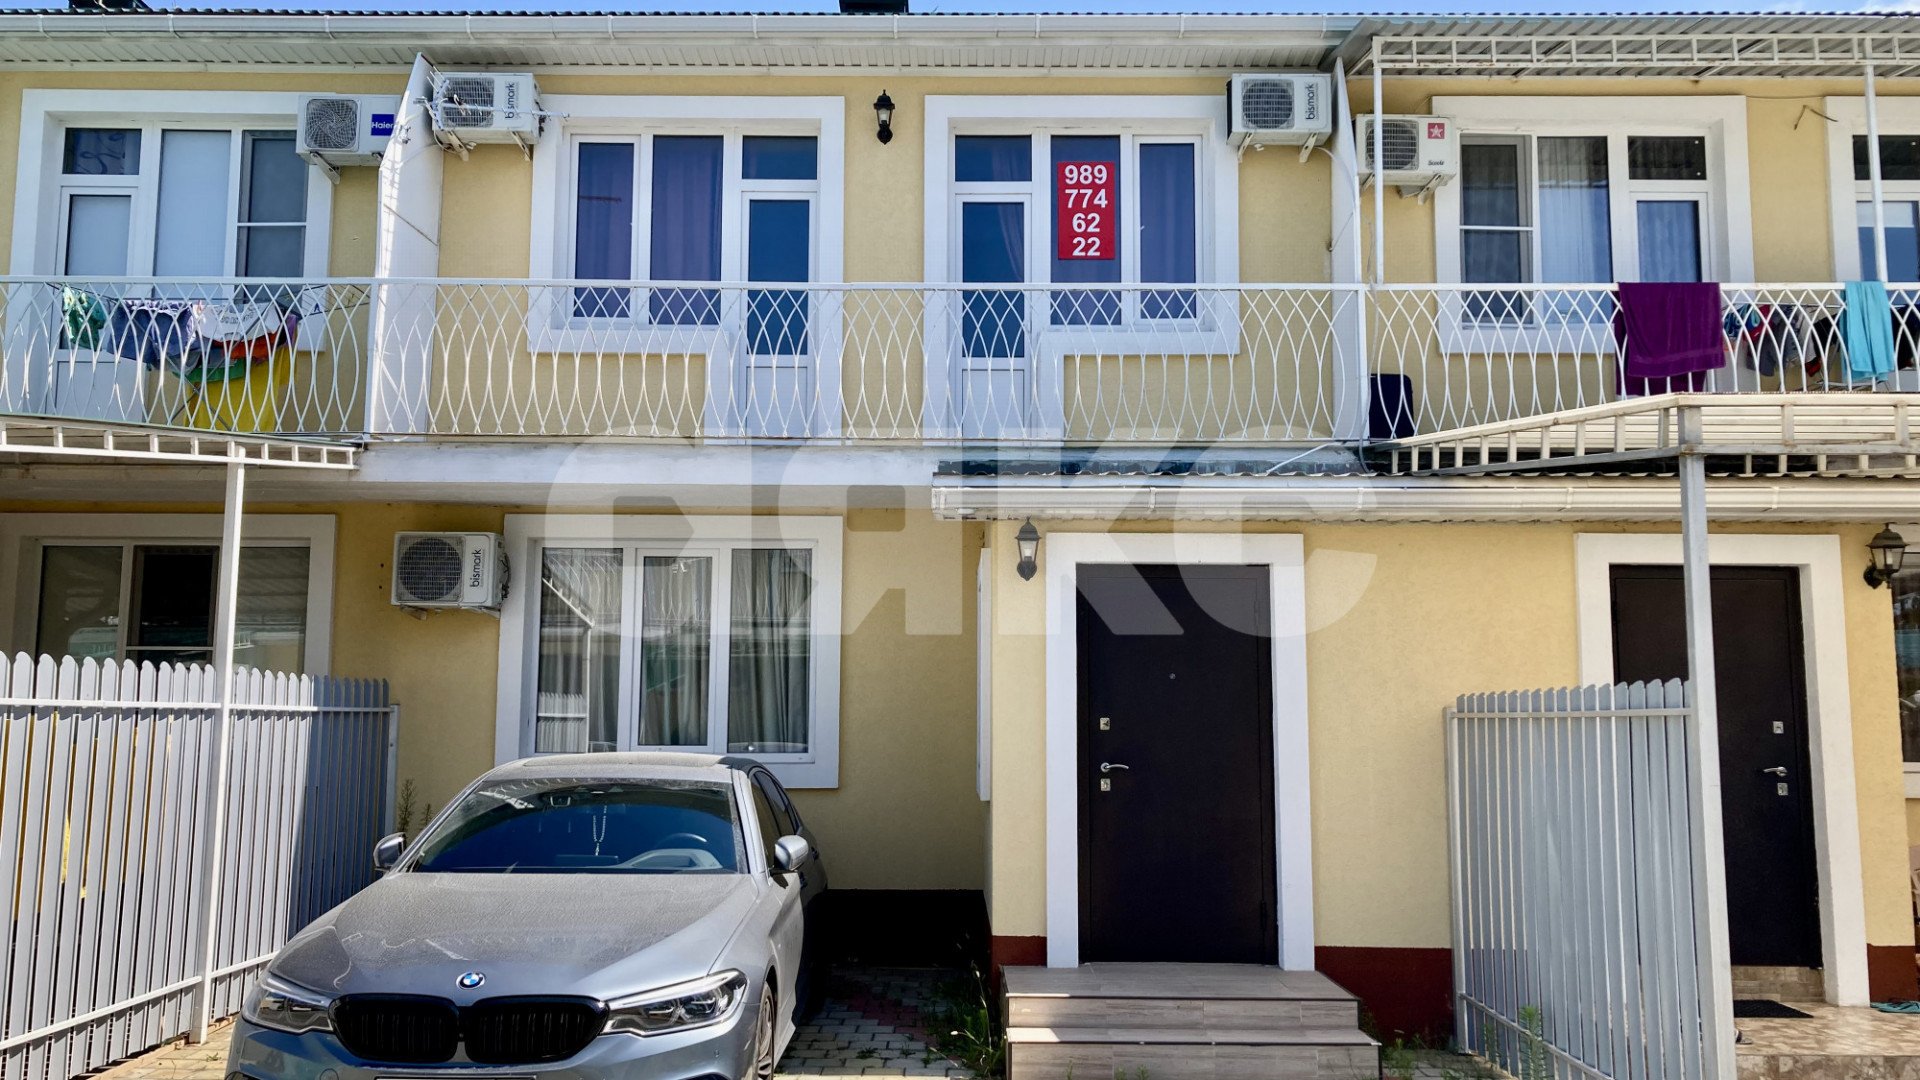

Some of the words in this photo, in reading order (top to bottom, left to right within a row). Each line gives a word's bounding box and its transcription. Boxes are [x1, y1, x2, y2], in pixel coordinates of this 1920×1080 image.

[505, 83, 515, 119] bsmark
[1305, 83, 1315, 120] bismark
[371, 121, 394, 129] Haier
[1064, 164, 1107, 185] 989
[1065, 188, 1108, 208] 774
[1072, 212, 1100, 233] 62
[1072, 236, 1100, 256] 22
[470, 548, 481, 587] bismark
